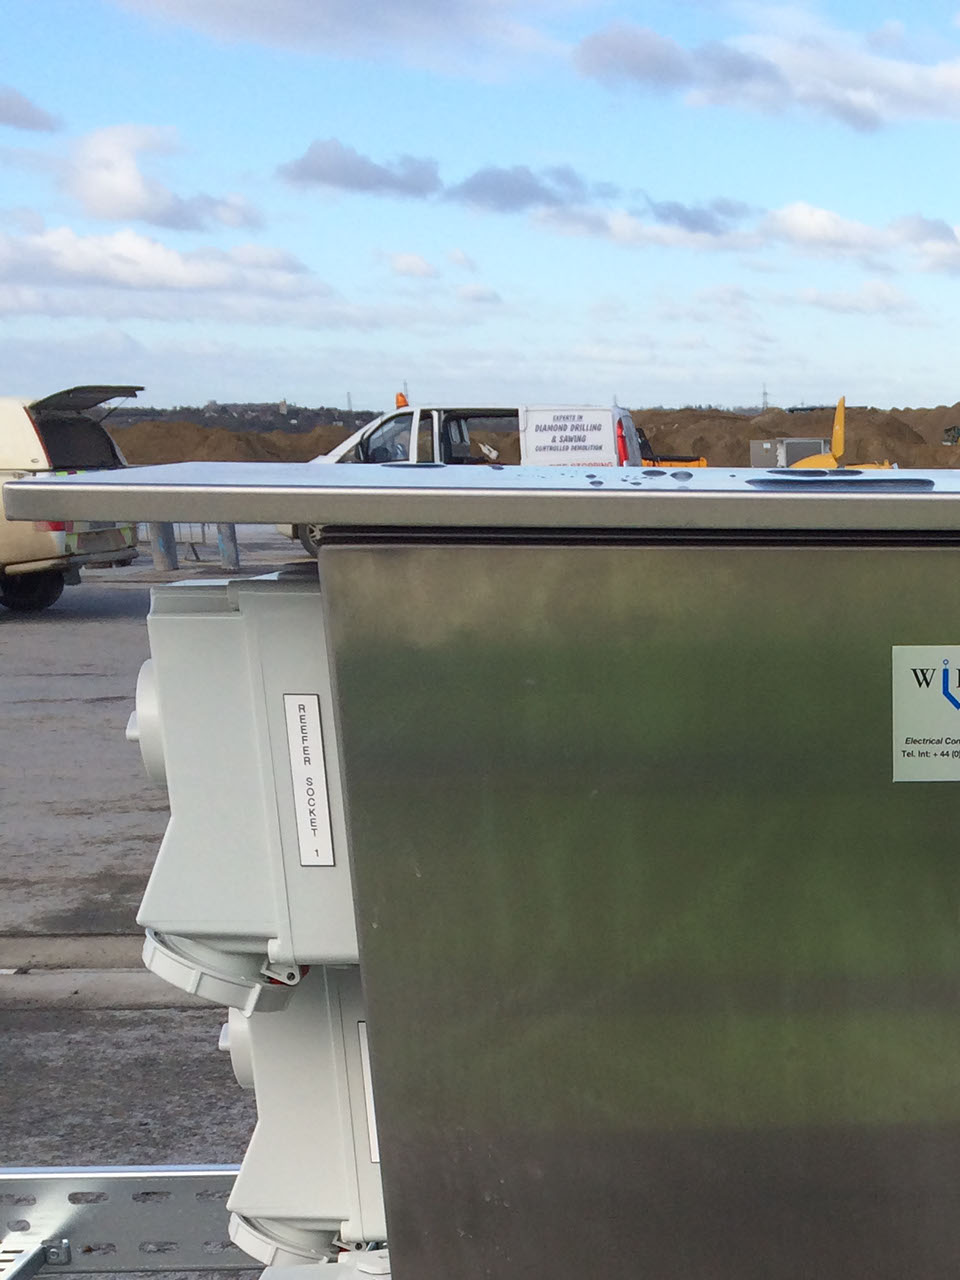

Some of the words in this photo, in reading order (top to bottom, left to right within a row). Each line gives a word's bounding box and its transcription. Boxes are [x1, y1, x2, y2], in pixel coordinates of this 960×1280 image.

[535, 424, 569, 432] DIAMOND
[570, 423, 602, 432] DRILLING
[551, 435, 557, 443] &
[559, 435, 587, 443] SAWING
[570, 444, 603, 452] DEMOLITION
[904, 737, 944, 745] Electrical
[901, 750, 916, 758] Tel.
[918, 750, 931, 758] Int:
[298, 703, 312, 766] REEFER
[305, 776, 318, 837] SOCKET
